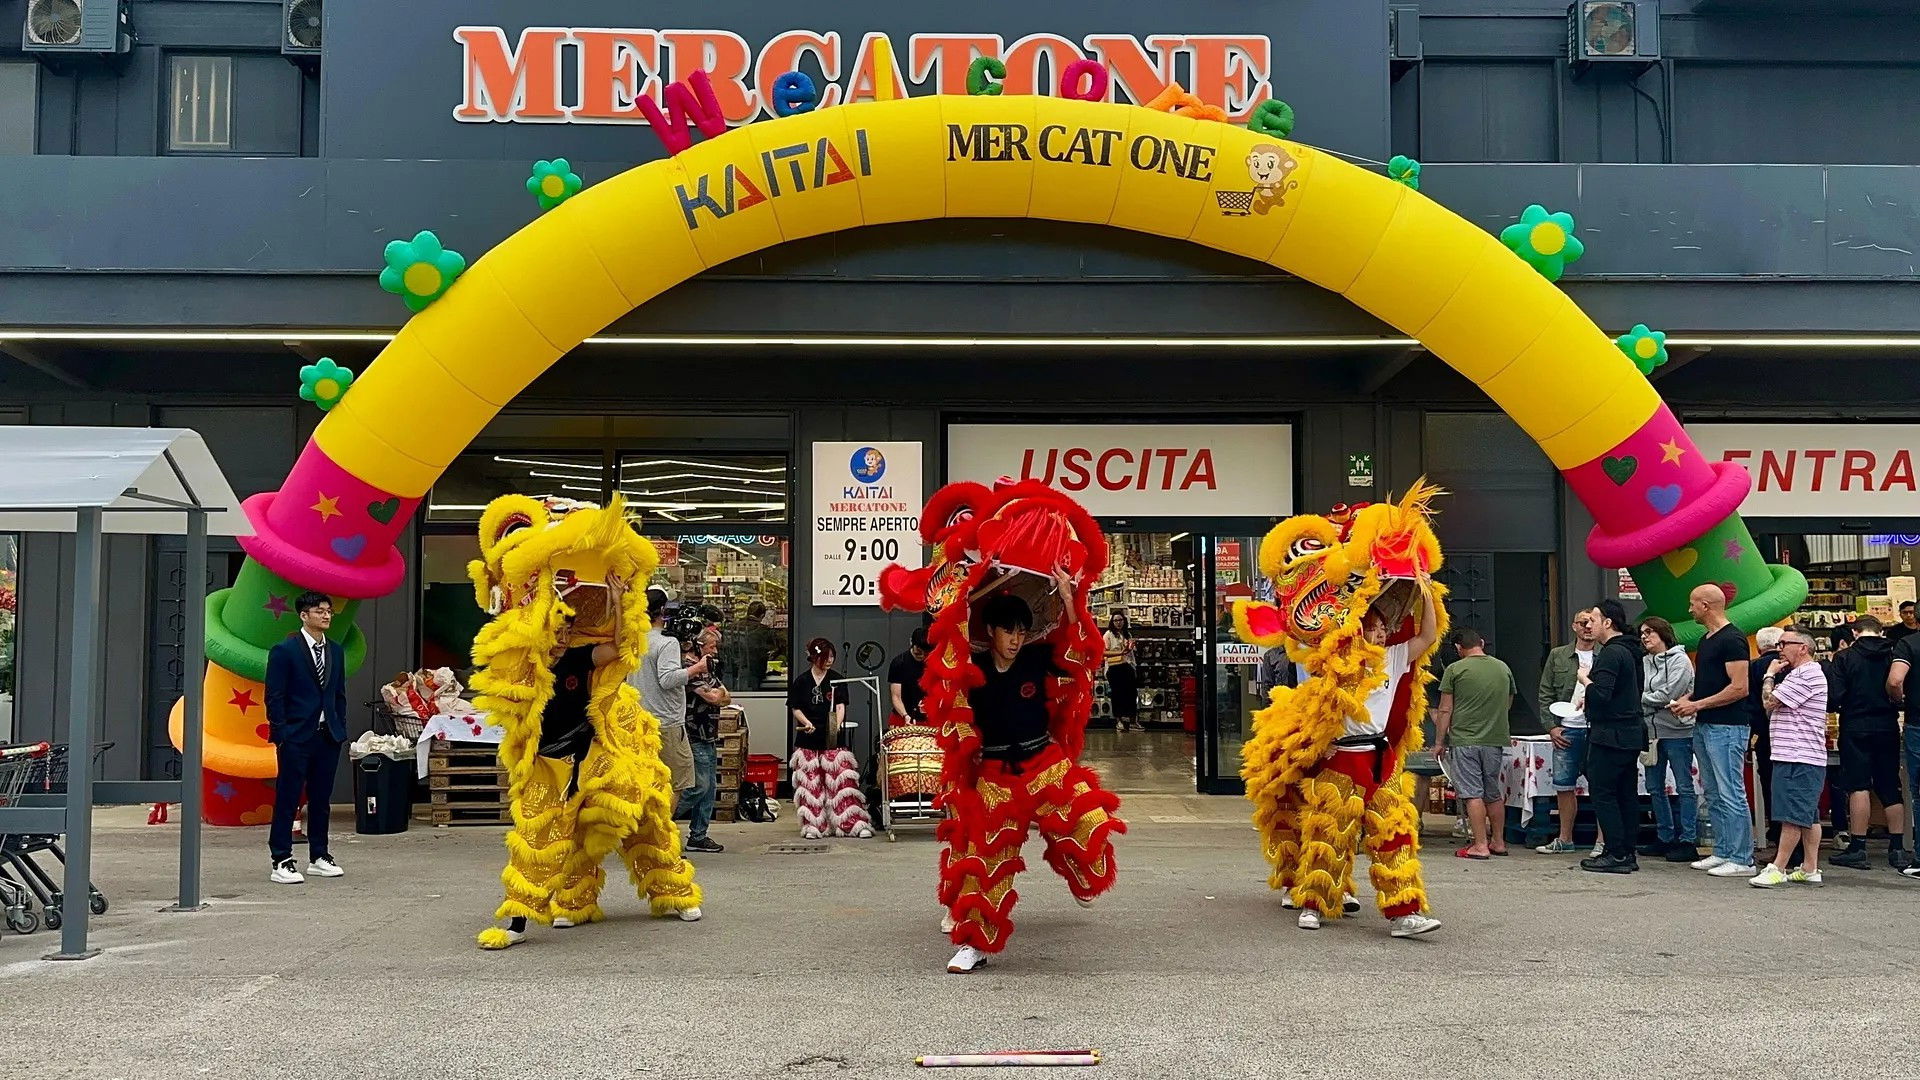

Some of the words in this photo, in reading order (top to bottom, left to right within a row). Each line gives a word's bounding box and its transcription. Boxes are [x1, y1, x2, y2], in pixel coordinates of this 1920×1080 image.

[453, 26, 1271, 125] MERCATONE
[674, 129, 871, 230] KAITAI
[1020, 447, 1217, 491] USCITA
[843, 486, 893, 499] KAITAI
[829, 502, 907, 512] MERCATONE
[817, 516, 867, 532] SEMPRE
[870, 516, 918, 532] APERTO
[844, 538, 899, 561] 9:00
[1223, 645, 1259, 654] KAITAI
